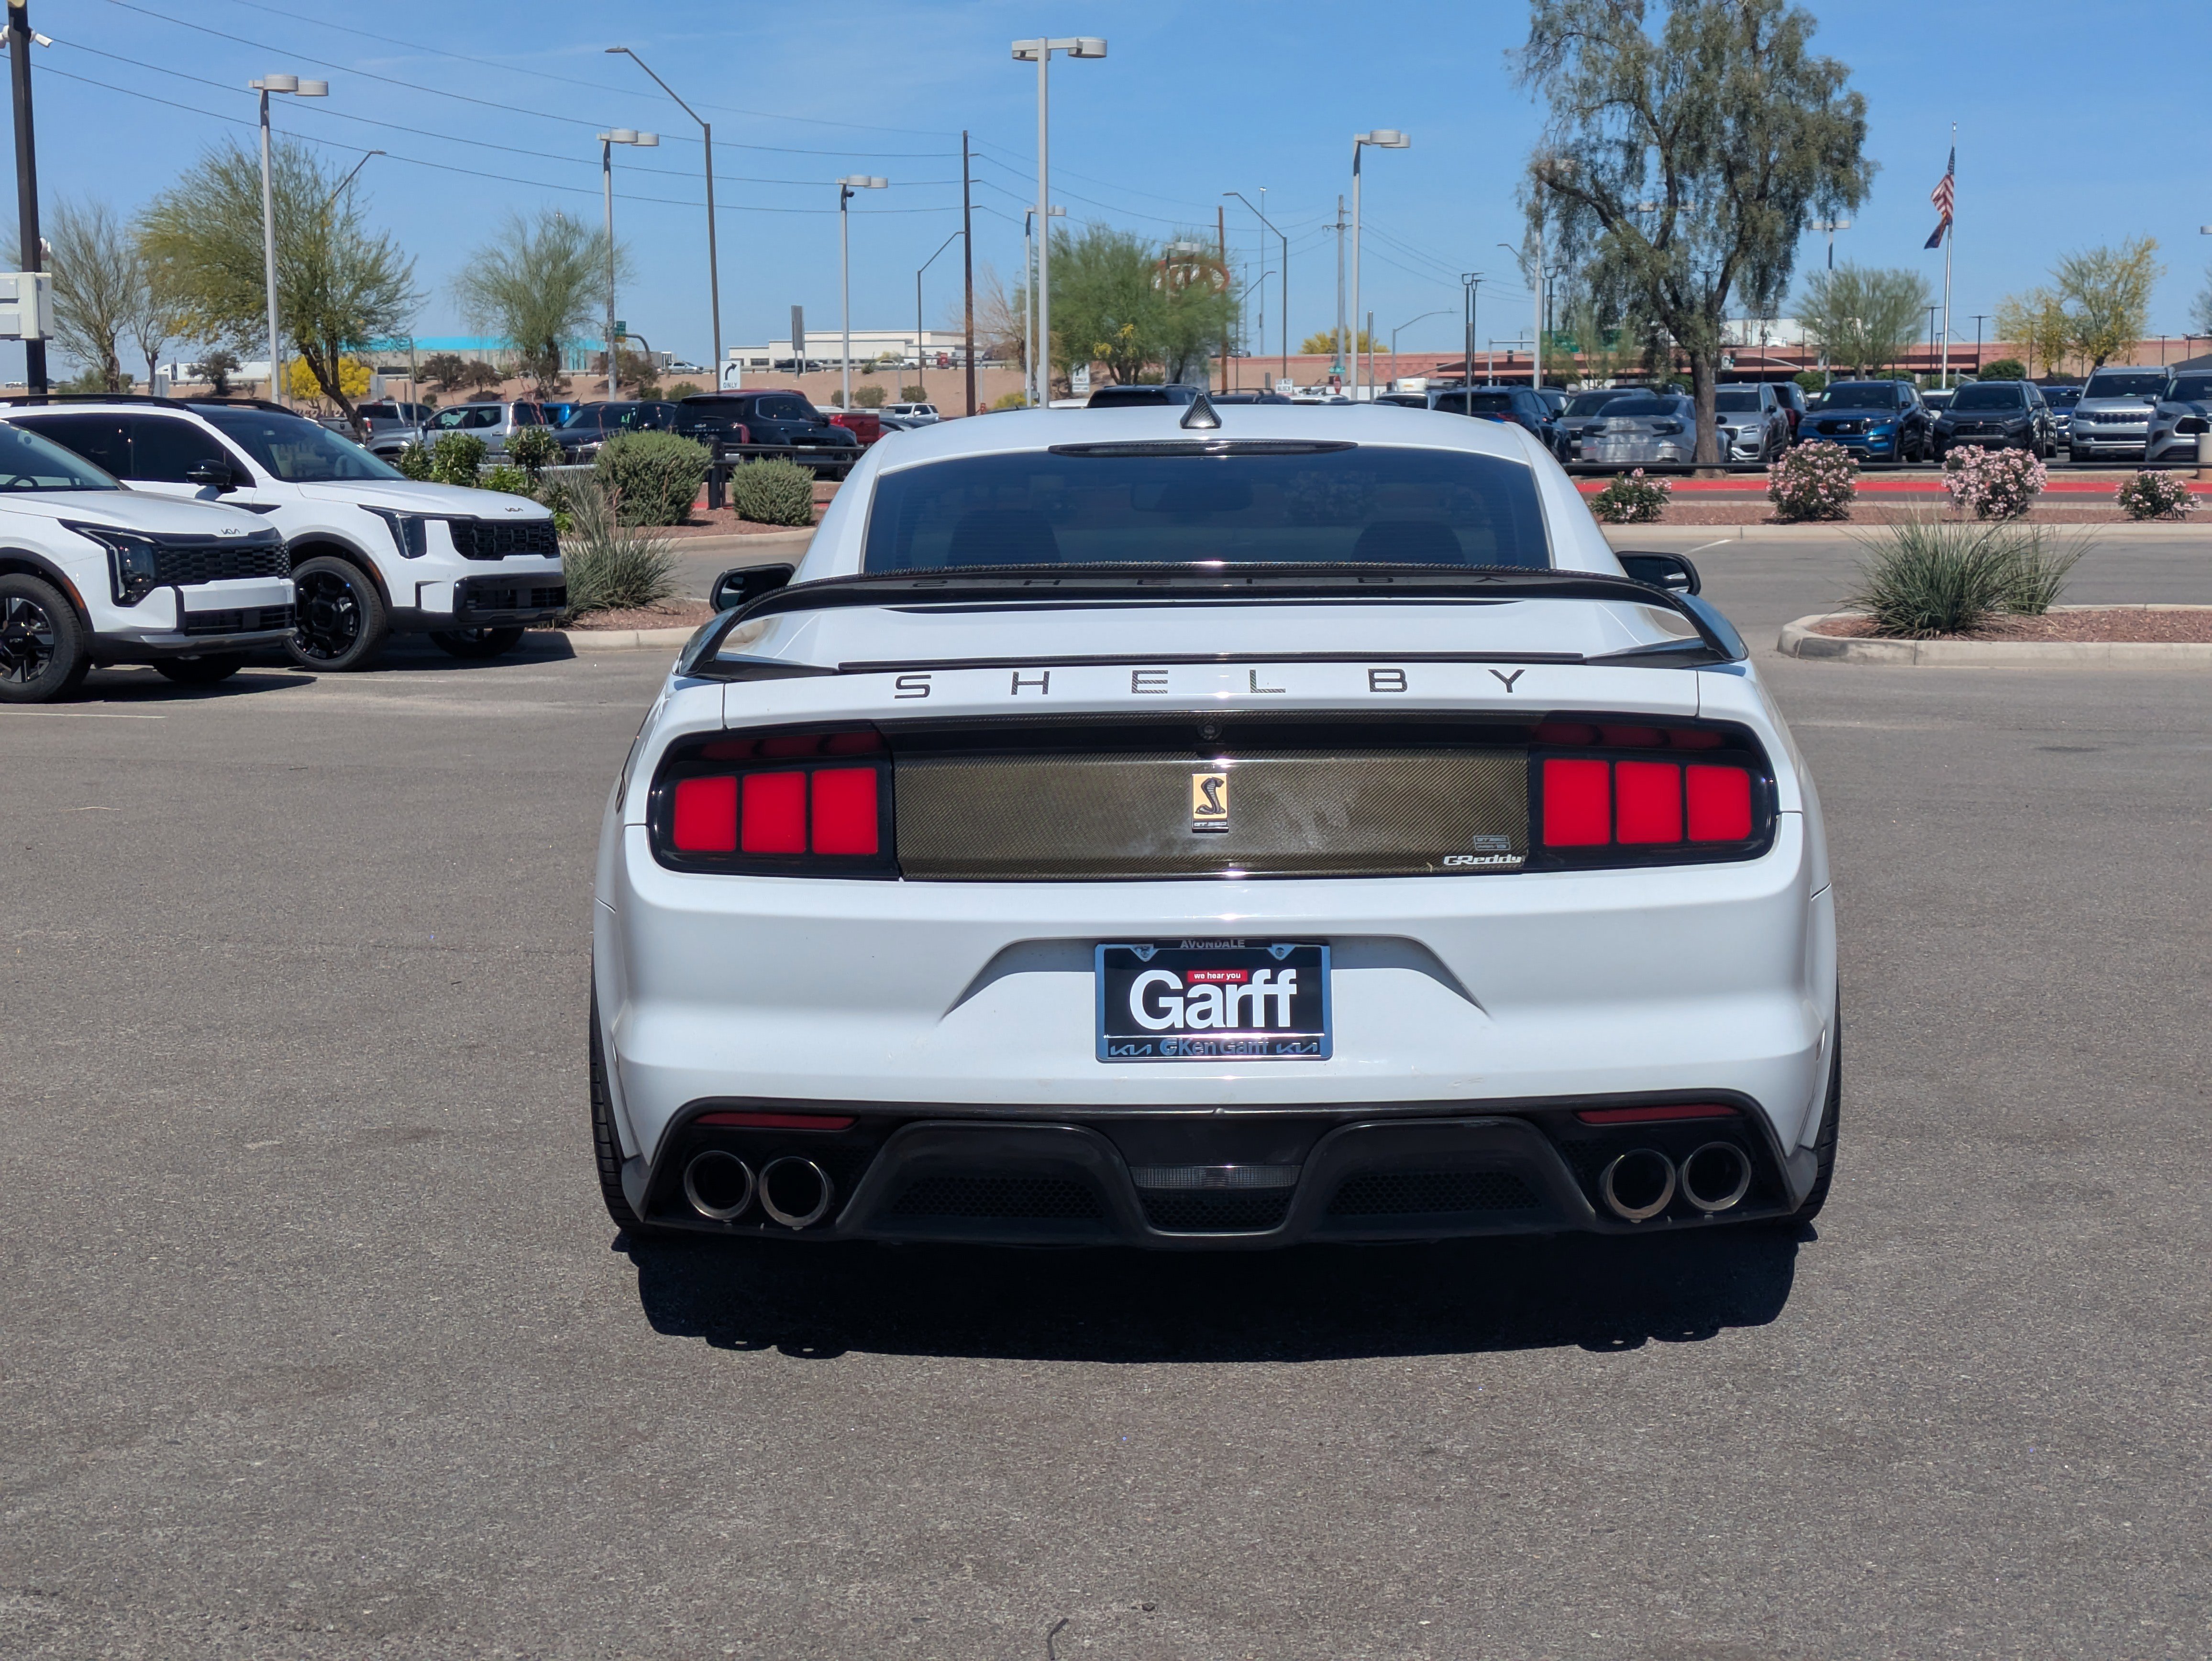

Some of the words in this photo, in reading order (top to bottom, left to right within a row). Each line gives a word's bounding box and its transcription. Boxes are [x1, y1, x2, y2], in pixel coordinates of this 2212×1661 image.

[894, 668, 1526, 699] SHELBY
[1443, 854, 1522, 865] GReddy
[1180, 939, 1245, 948] AVONDALE
[1129, 969, 1297, 1030] Garff
[1179, 1038, 1217, 1056] Ken
